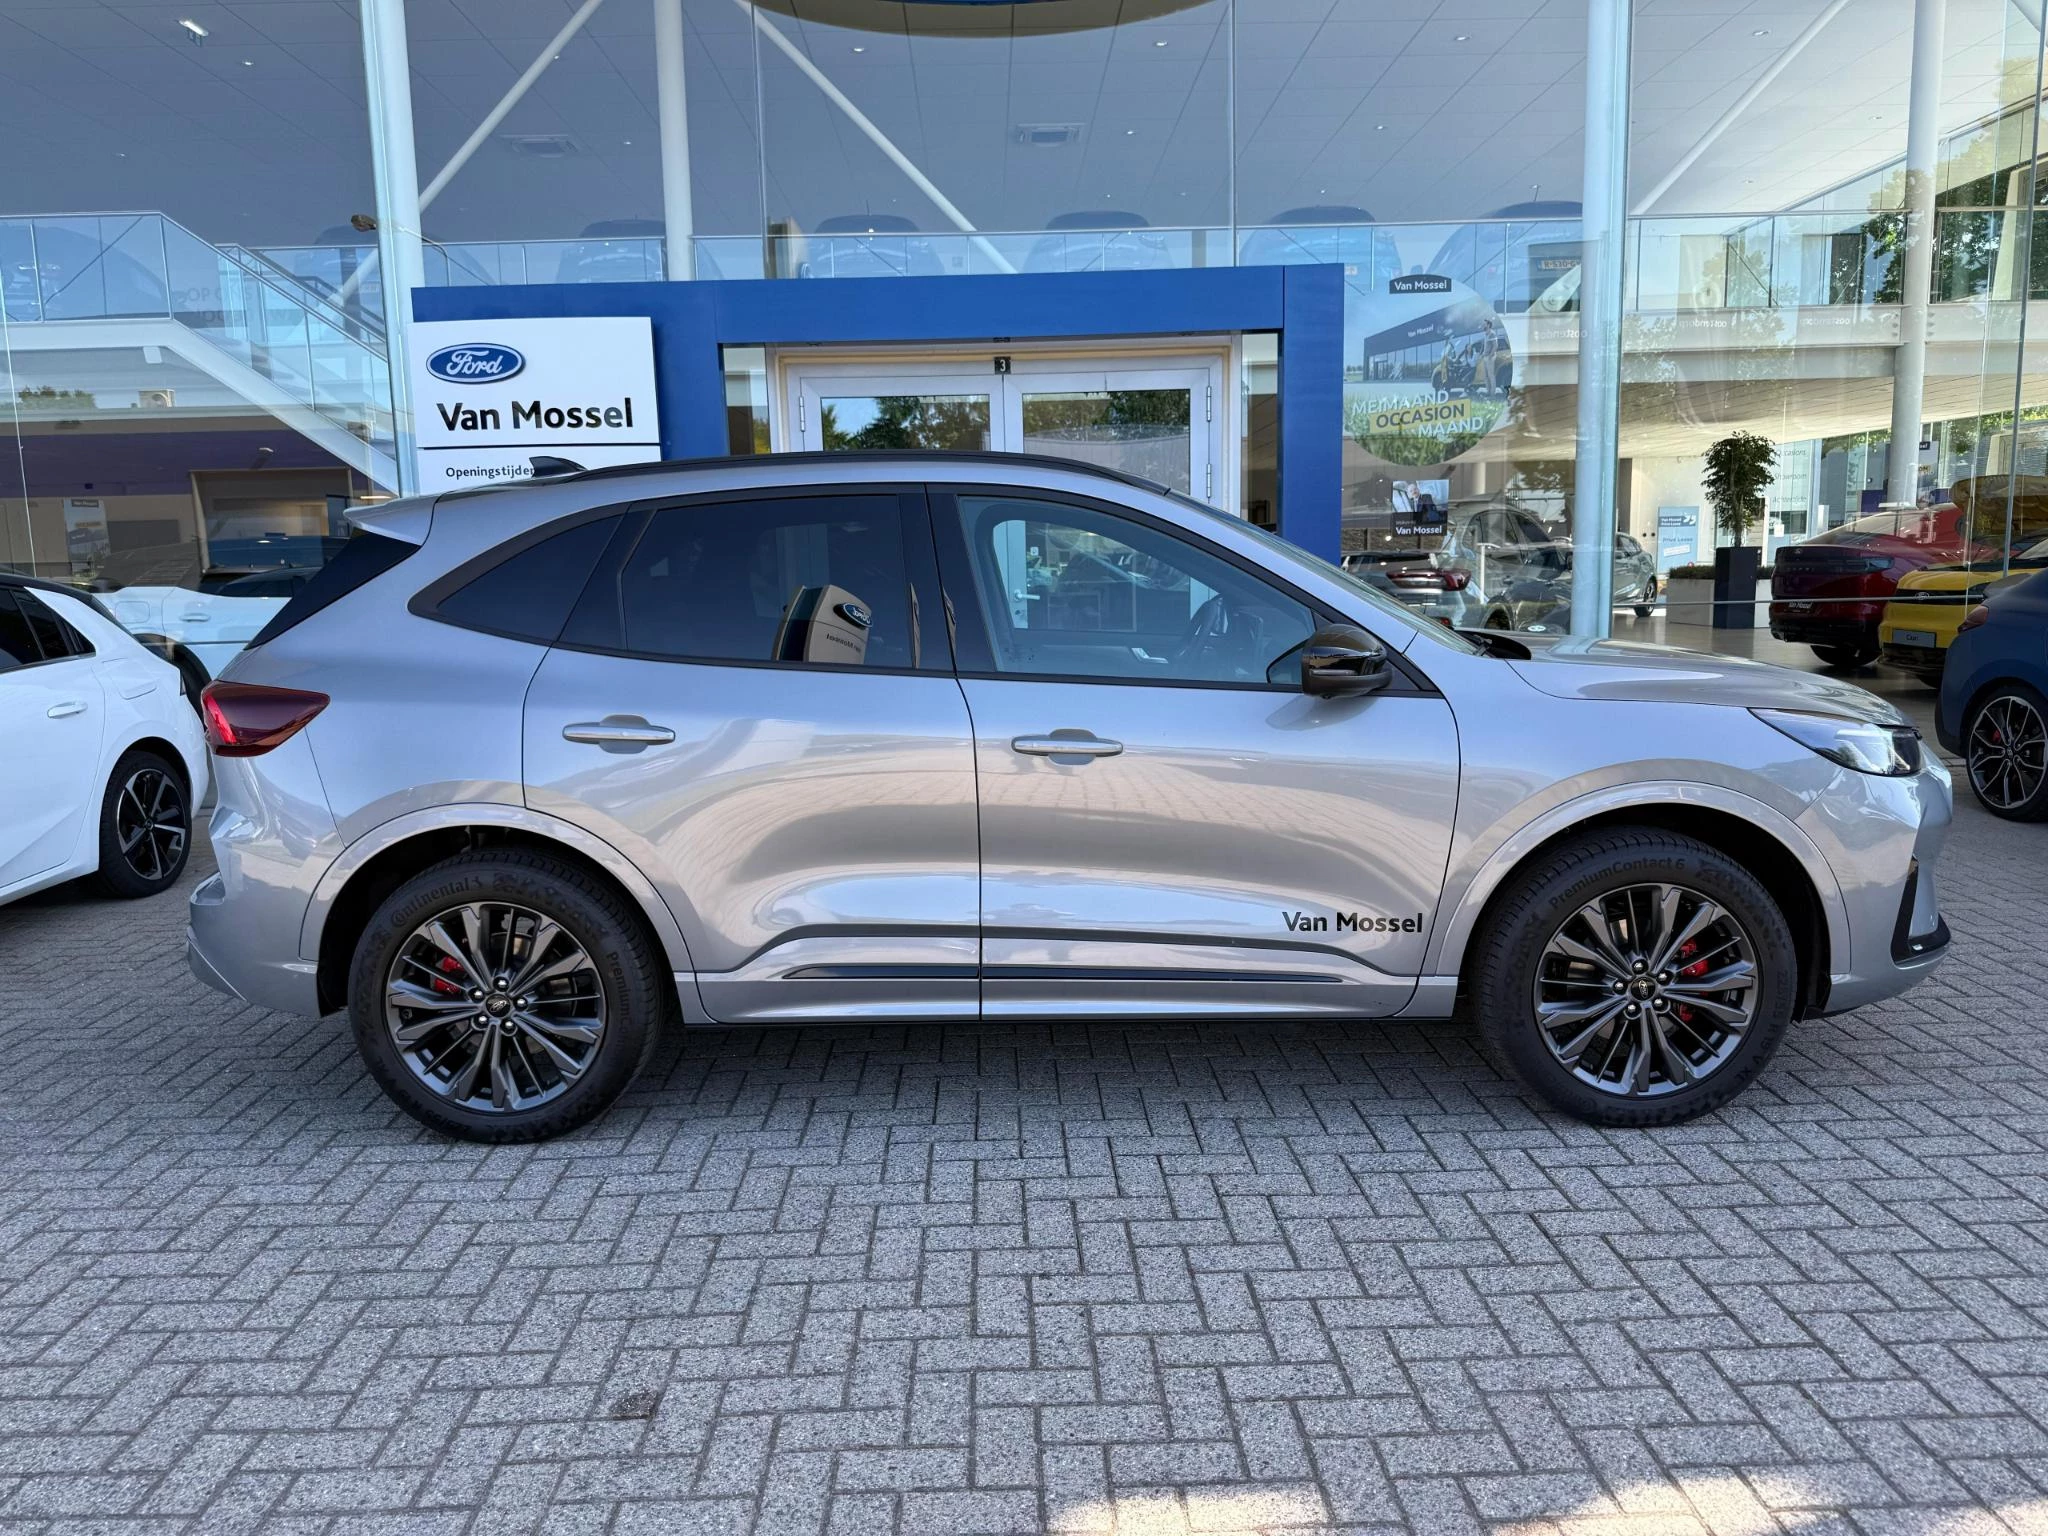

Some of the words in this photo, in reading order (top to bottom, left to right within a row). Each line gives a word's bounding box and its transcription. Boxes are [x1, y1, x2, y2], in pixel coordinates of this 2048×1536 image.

[1394, 281, 1412, 291] Van
[1414, 279, 1447, 290] Mossel
[445, 349, 504, 376] Ford
[1000, 359, 1006, 372] 3
[437, 402, 500, 431] Van
[511, 397, 633, 429] Mossel
[1376, 403, 1465, 428] OCCASION
[1418, 416, 1484, 438] MAAND
[1395, 526, 1412, 535] Van
[1413, 524, 1443, 534] Mossel
[1548, 858, 1670, 909] PremiumContact
[1674, 858, 1685, 870] 6
[391, 877, 471, 927] Continental
[1282, 911, 1327, 932] Van
[1336, 911, 1423, 933] Mossel
